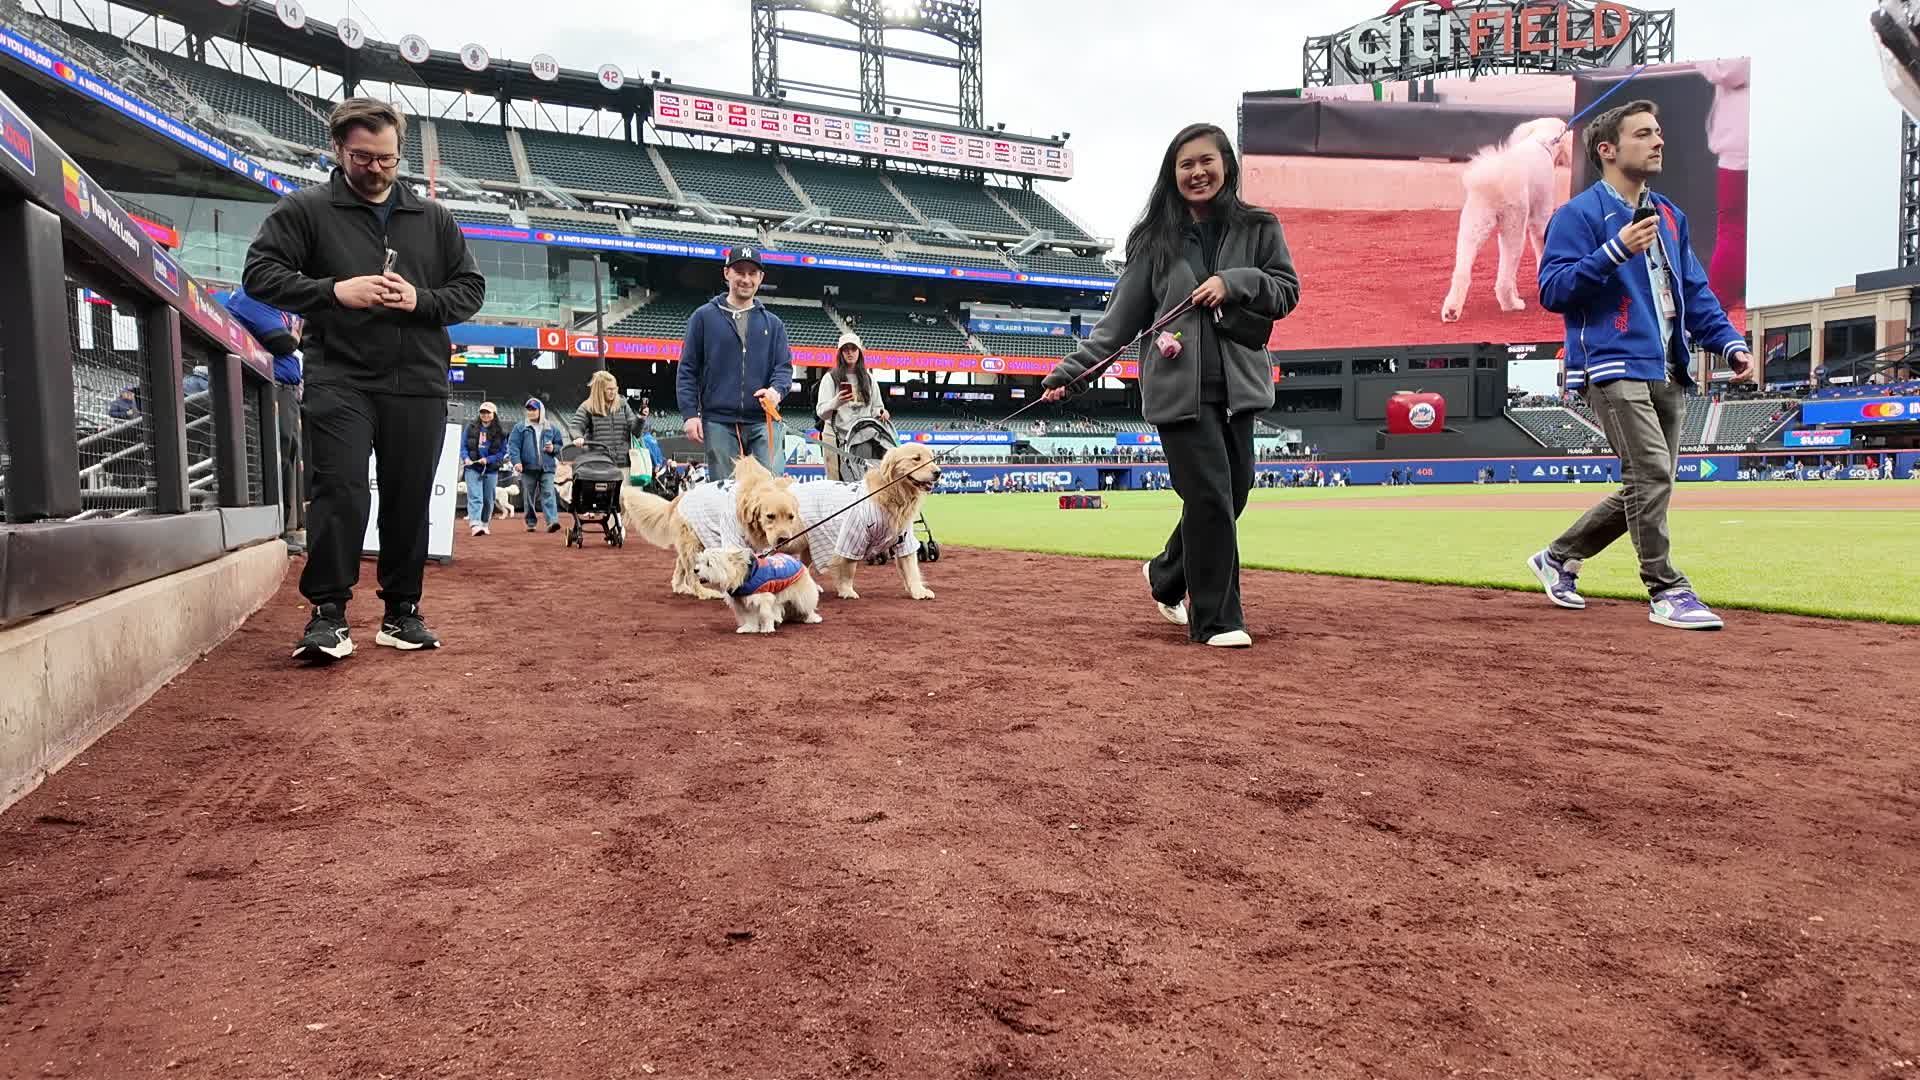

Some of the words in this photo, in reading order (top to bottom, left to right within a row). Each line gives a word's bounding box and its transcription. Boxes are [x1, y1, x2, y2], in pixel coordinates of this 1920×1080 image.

[284, 4, 297, 20] 14
[343, 25, 359, 41] 37
[1350, 4, 1451, 63] citi
[1468, 2, 1631, 58] FIELD
[534, 61, 556, 74] SHEA
[602, 70, 619, 84] 42
[762, 122, 779, 130] ATL
[91, 193, 107, 224] New
[106, 208, 121, 238] York
[120, 221, 140, 258] Lottery
[994, 323, 1022, 332] MILAGRO
[1023, 325, 1048, 333] TEQUILA
[547, 332, 560, 346] 0
[1800, 435, 1835, 445] $1,500
[1679, 444, 1710, 453] HubSpot
[1716, 443, 1747, 452] HubSpot
[1416, 468, 1433, 476] 408
[1550, 465, 1602, 475] DELTA
